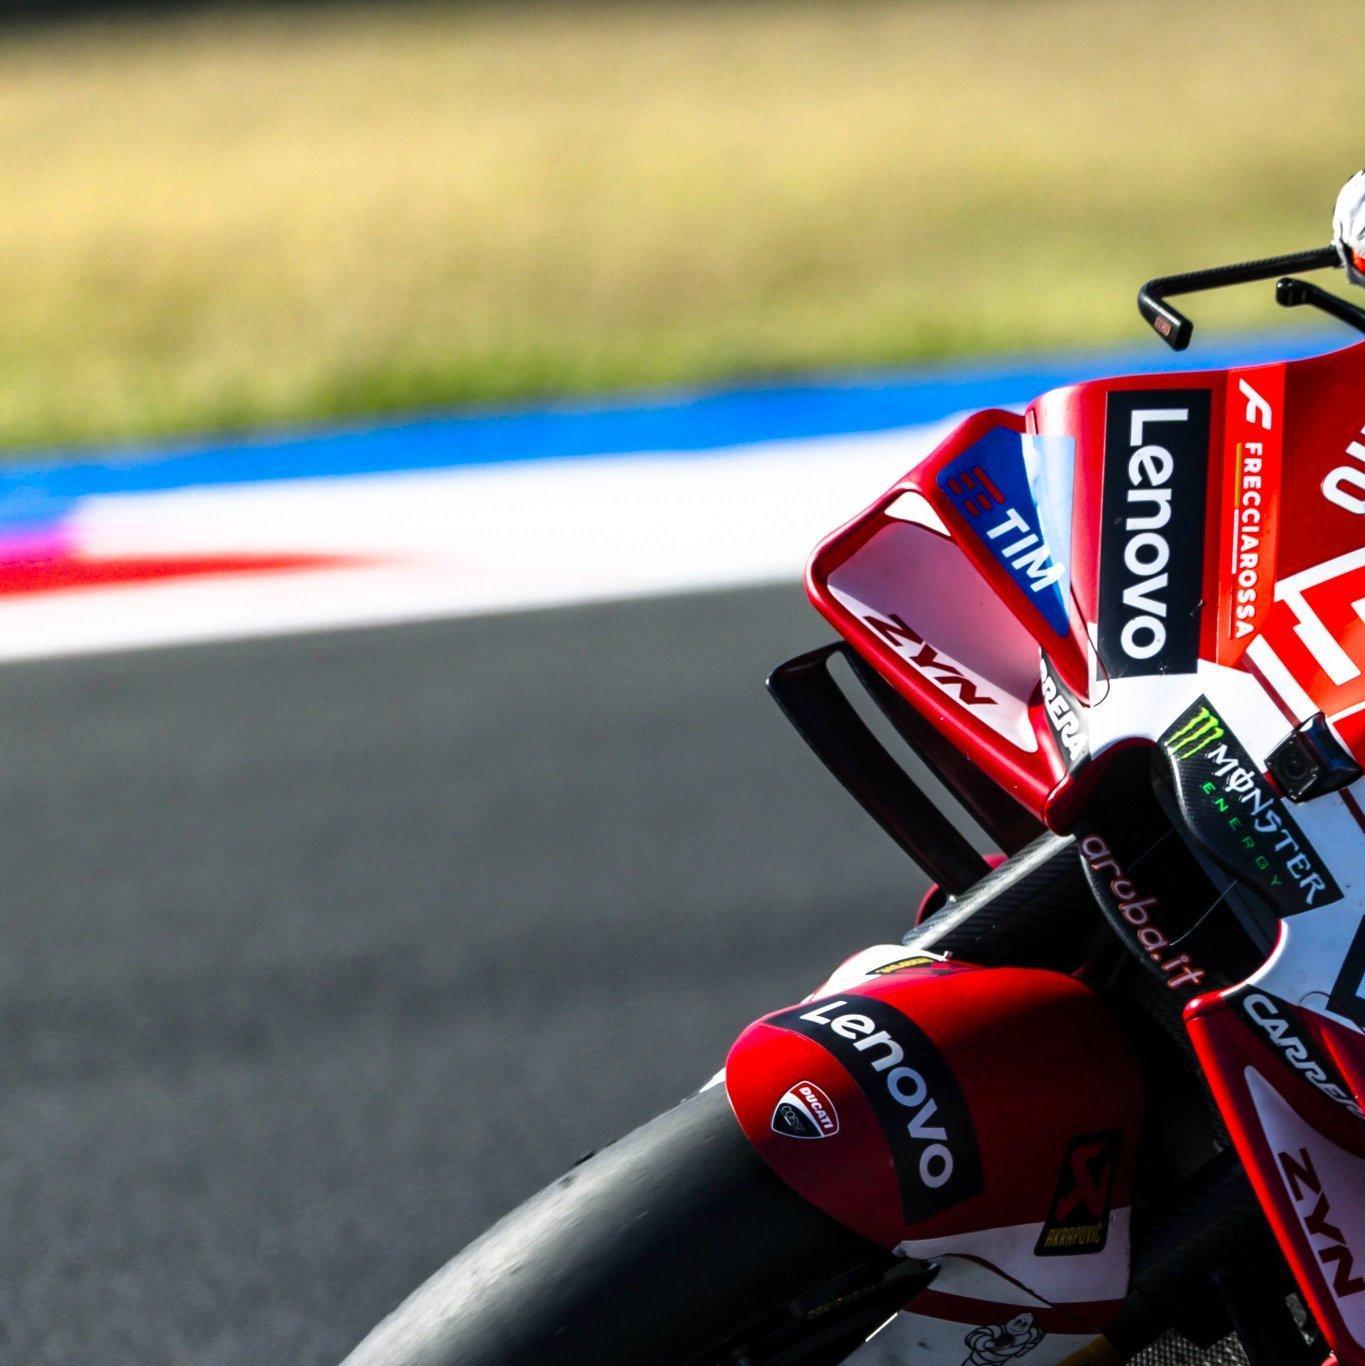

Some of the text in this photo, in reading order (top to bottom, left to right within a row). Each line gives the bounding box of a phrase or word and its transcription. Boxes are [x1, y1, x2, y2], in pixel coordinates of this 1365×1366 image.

[985, 506, 1066, 594] TIM
[1119, 407, 1190, 661] Lenovo
[1235, 441, 1264, 640] FRECCIAROSSA
[863, 612, 999, 707] ZYN
[1200, 780, 1282, 889] ENERGY
[1207, 741, 1328, 906] MONSTER
[1079, 833, 1206, 991] aruba.it
[798, 1086, 835, 1129] DUCATI
[799, 999, 955, 1189] Lenovo
